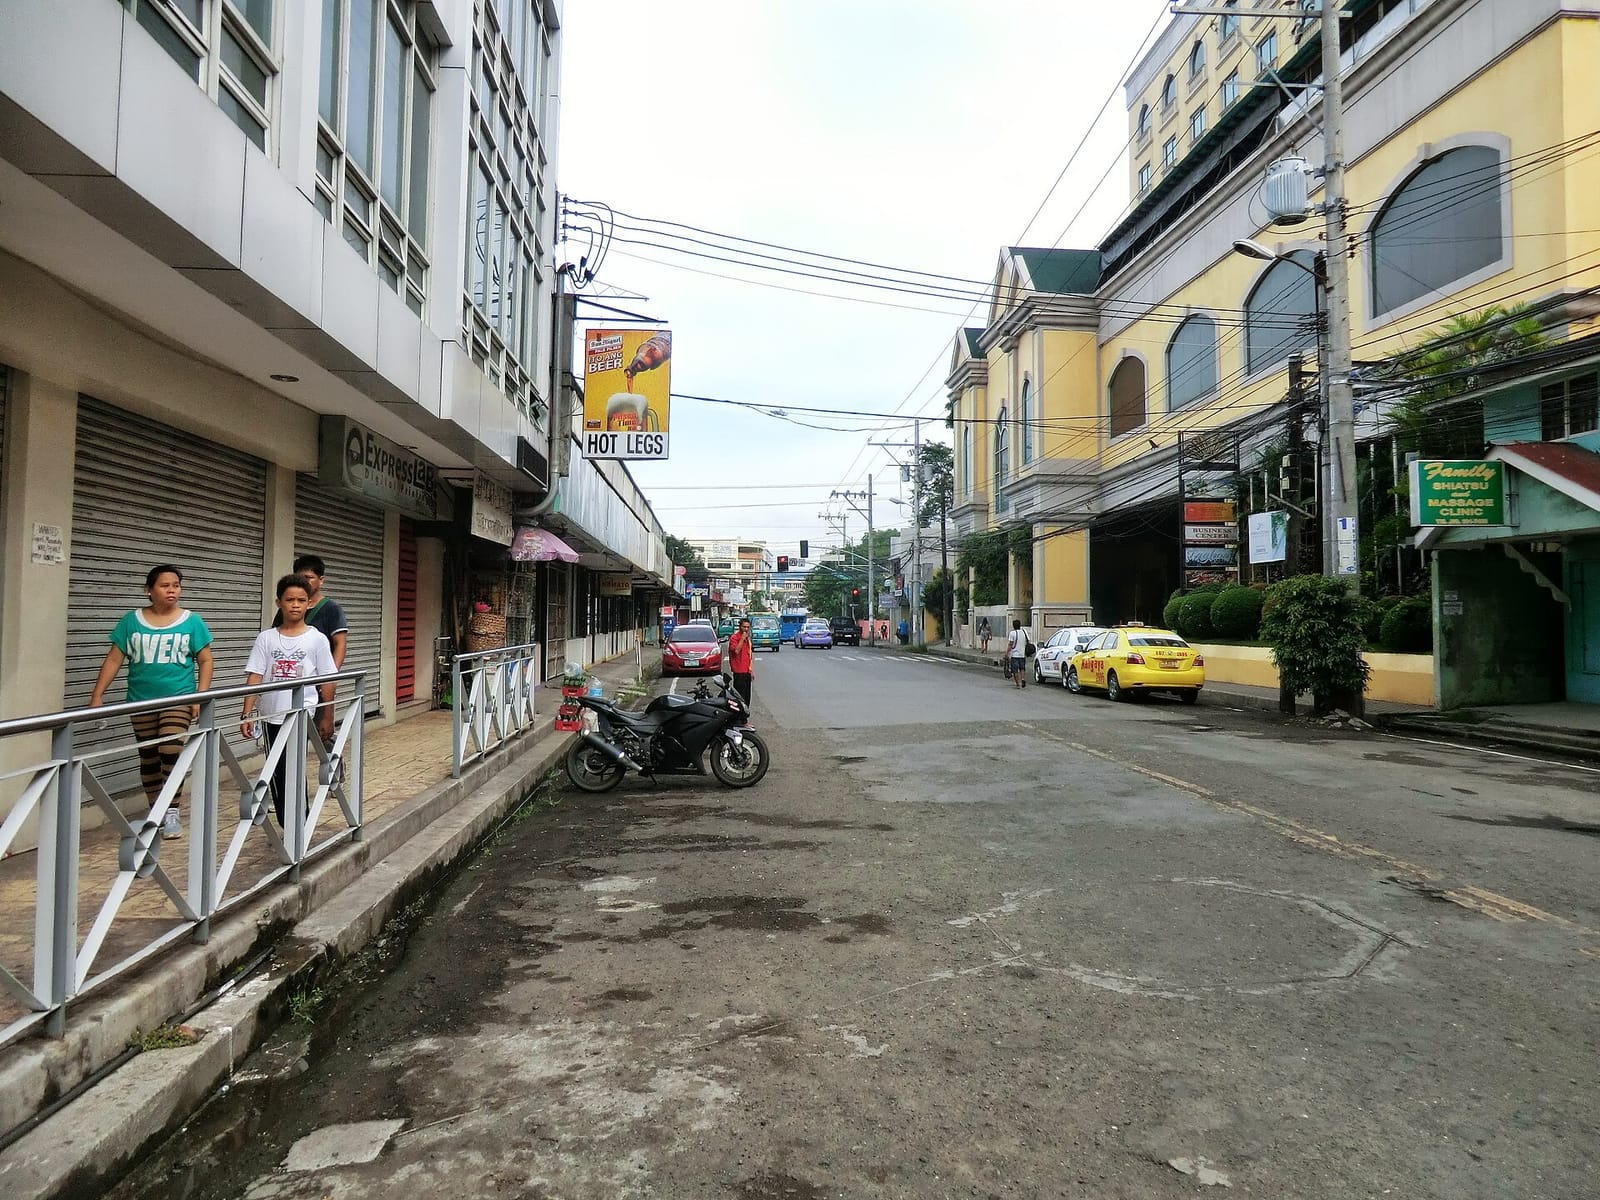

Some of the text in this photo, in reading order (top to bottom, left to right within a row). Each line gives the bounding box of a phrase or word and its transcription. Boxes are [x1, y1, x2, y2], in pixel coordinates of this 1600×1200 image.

[605, 351, 623, 361] ANG
[588, 358, 623, 374] BEER
[587, 433, 664, 454] HOT LEGS
[1423, 462, 1497, 481] Family
[1432, 481, 1489, 490] SHIATSU
[1427, 498, 1495, 507] MASSAGE
[1439, 508, 1484, 516] CLINIC
